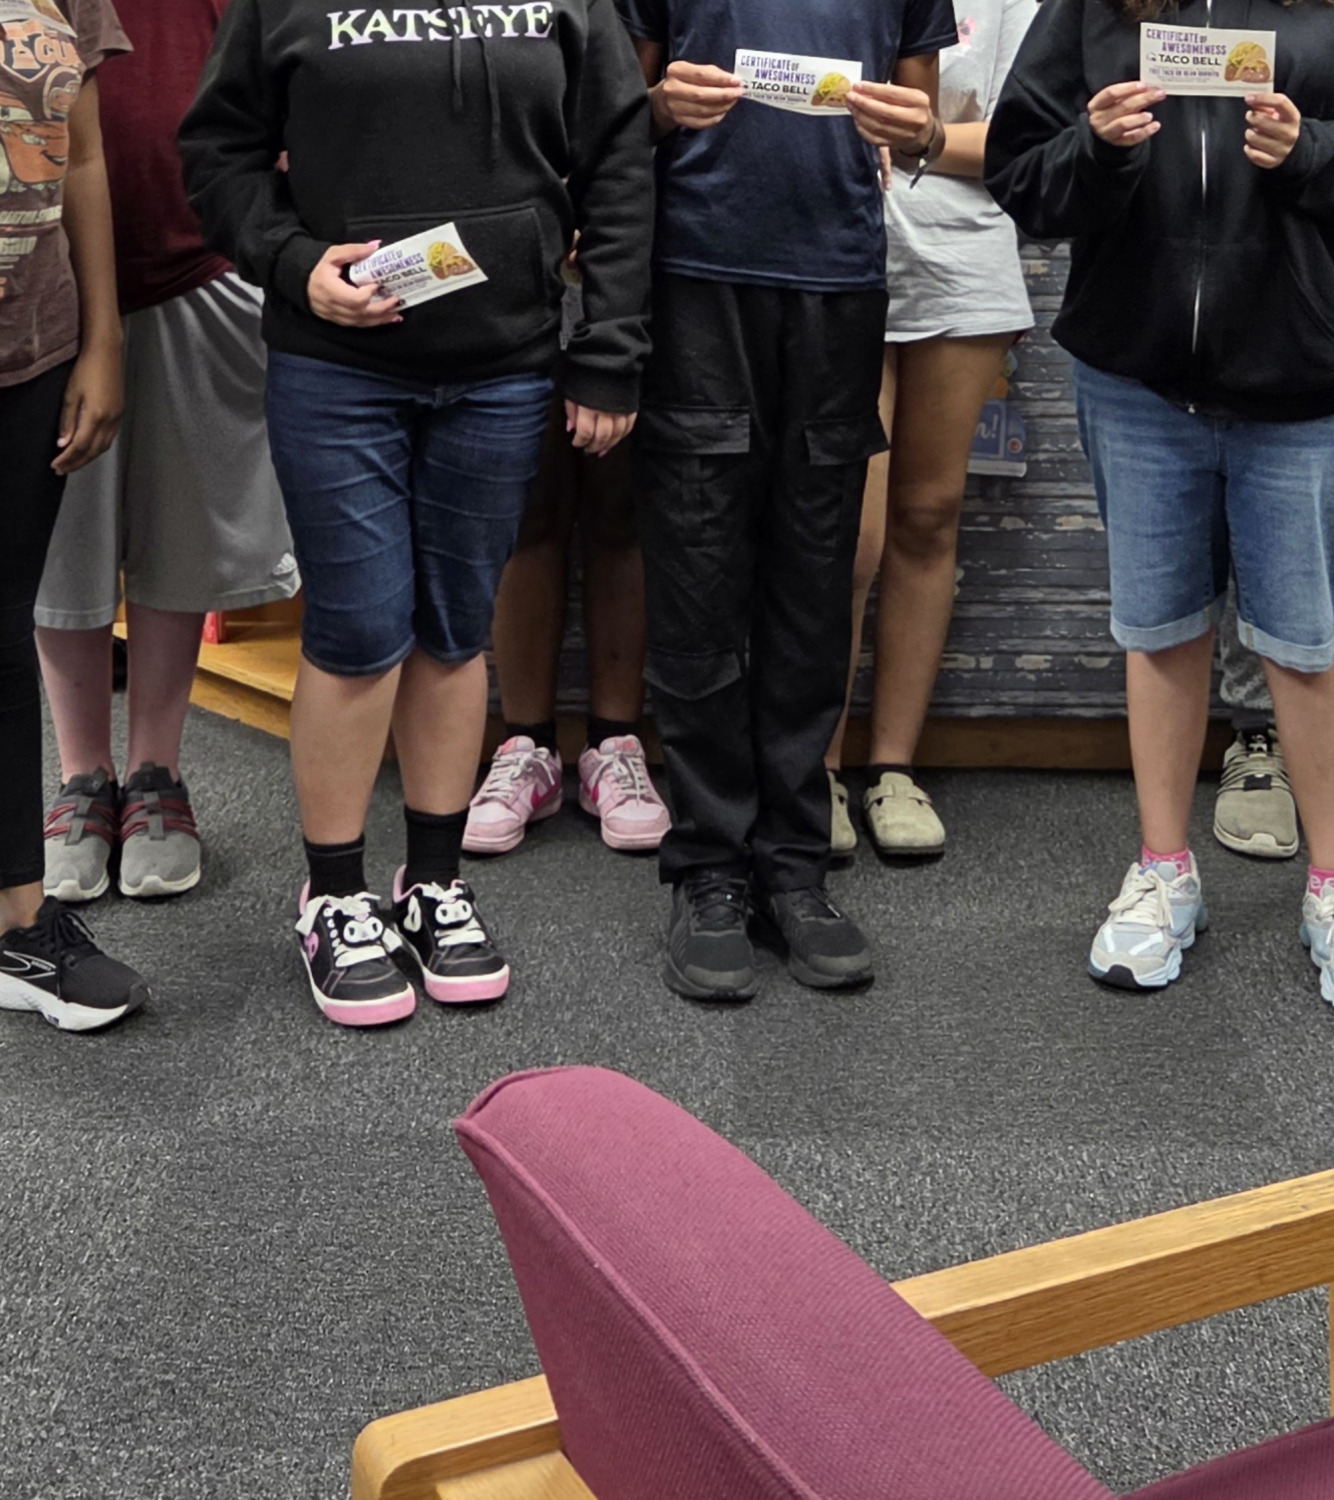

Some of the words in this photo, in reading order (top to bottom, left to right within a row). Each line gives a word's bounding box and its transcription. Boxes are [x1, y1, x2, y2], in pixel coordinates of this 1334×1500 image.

[326, 1, 554, 50] KATSEYE
[1146, 28, 1199, 43] CERTIFICATE
[1162, 42, 1227, 55] AWESOMENESS
[740, 55, 791, 71] CERTIFICATE
[1158, 54, 1189, 65] TACO
[1192, 56, 1222, 66] BELL
[755, 69, 816, 85] AWESOMENESS
[751, 81, 780, 92] TACO
[782, 85, 810, 95] BELL
[371, 253, 425, 279] AWESOMENESS
[402, 266, 428, 281] BELL
